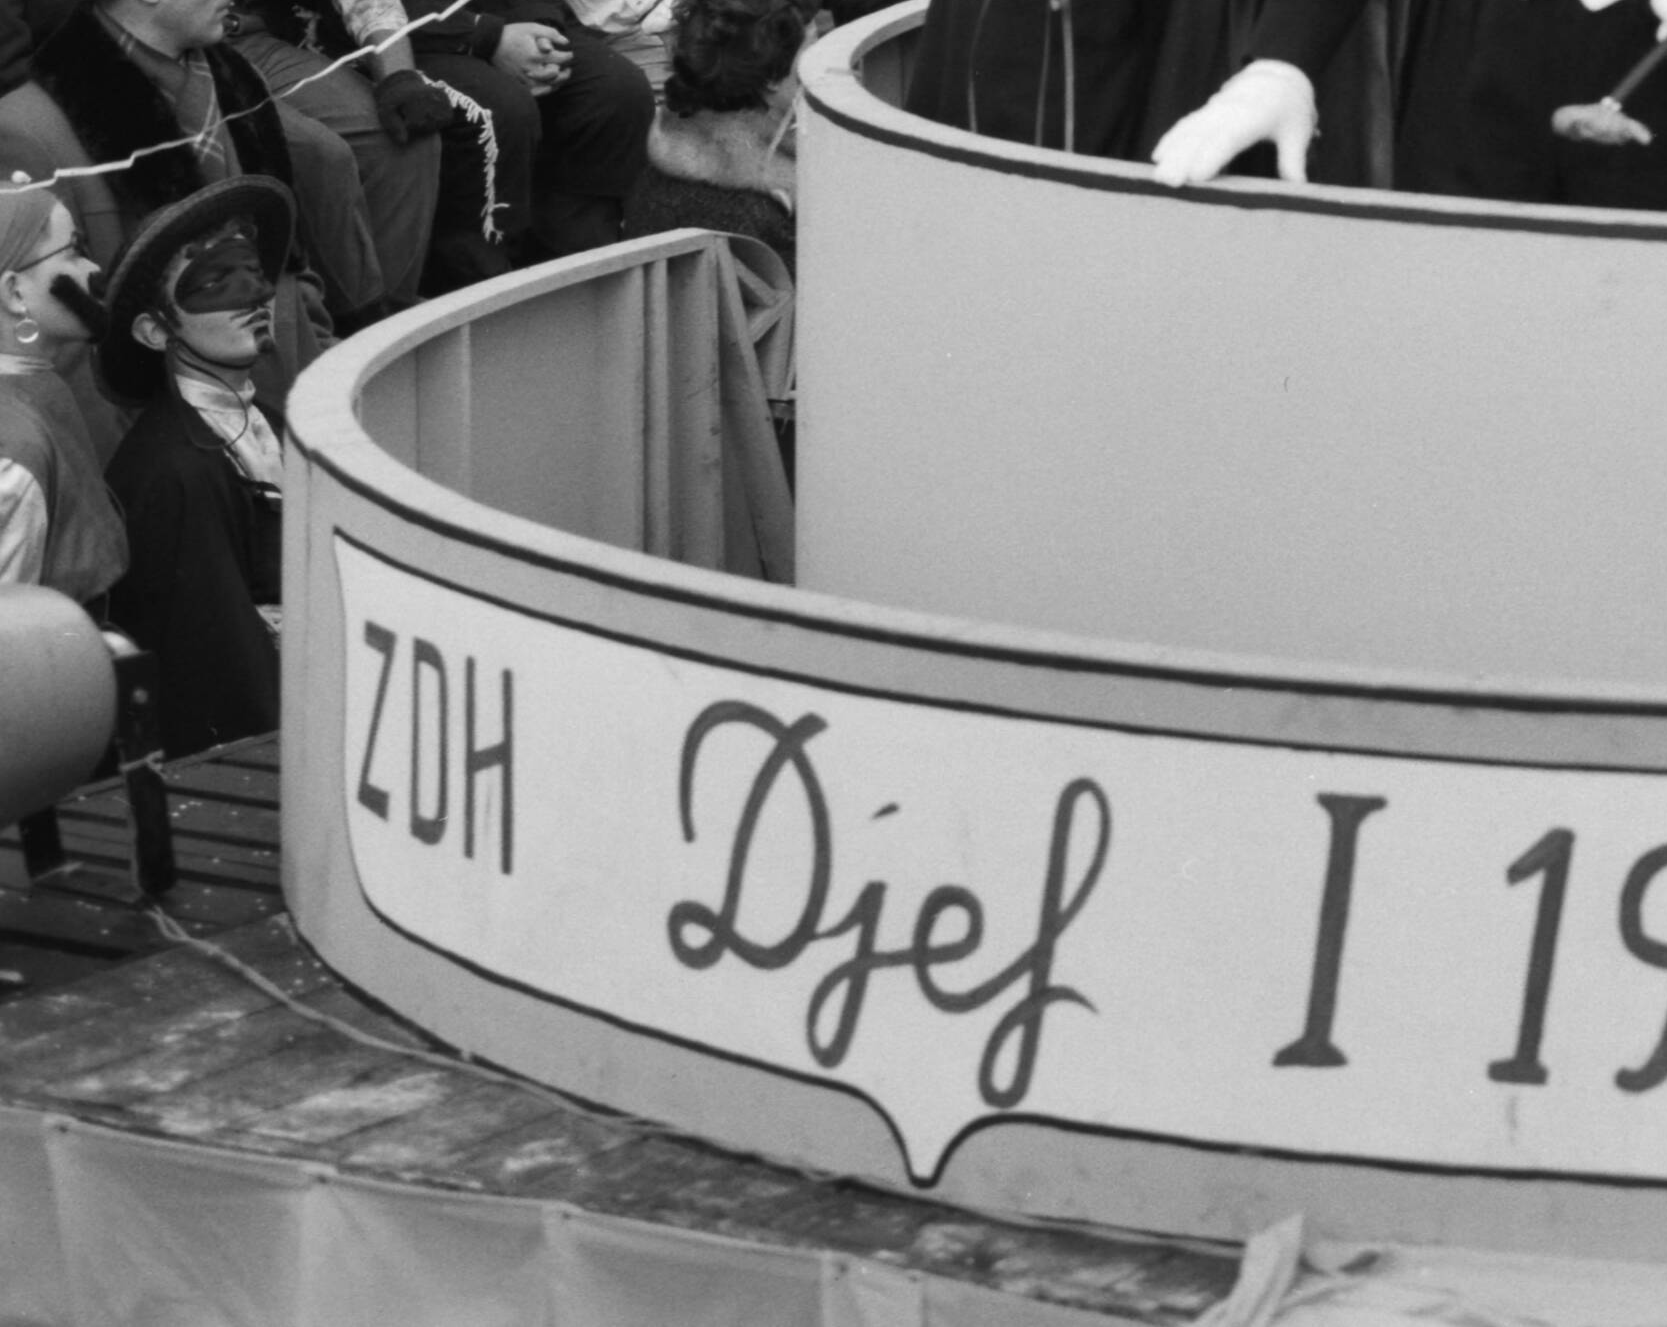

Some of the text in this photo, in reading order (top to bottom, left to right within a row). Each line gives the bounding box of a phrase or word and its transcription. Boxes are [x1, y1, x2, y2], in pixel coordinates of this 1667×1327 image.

[357, 622, 514, 875] ZDH
[668, 697, 1110, 1105] Djef
[1273, 792, 1388, 1069] I
